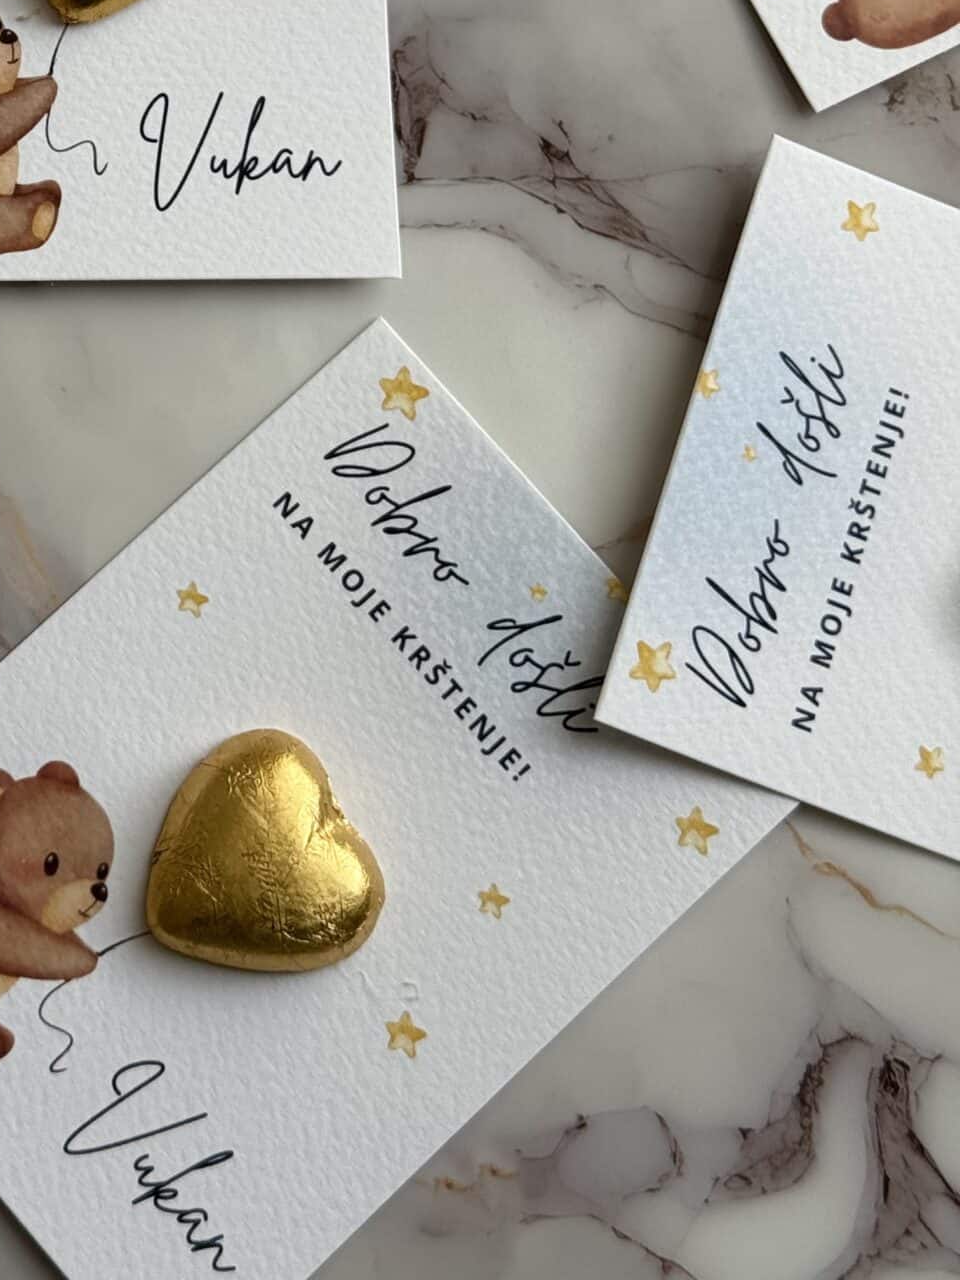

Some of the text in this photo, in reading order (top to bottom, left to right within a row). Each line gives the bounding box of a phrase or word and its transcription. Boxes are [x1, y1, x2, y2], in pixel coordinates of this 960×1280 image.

[139, 91, 343, 213] Vukan
[323, 422, 470, 587] Dobro
[684, 343, 847, 709] Dobro došli
[791, 387, 910, 733] NA MOJE KRŠTENJE!
[272, 491, 532, 783] NA MOJE KRŠTENJE!
[62, 1059, 237, 1273] Vukan
